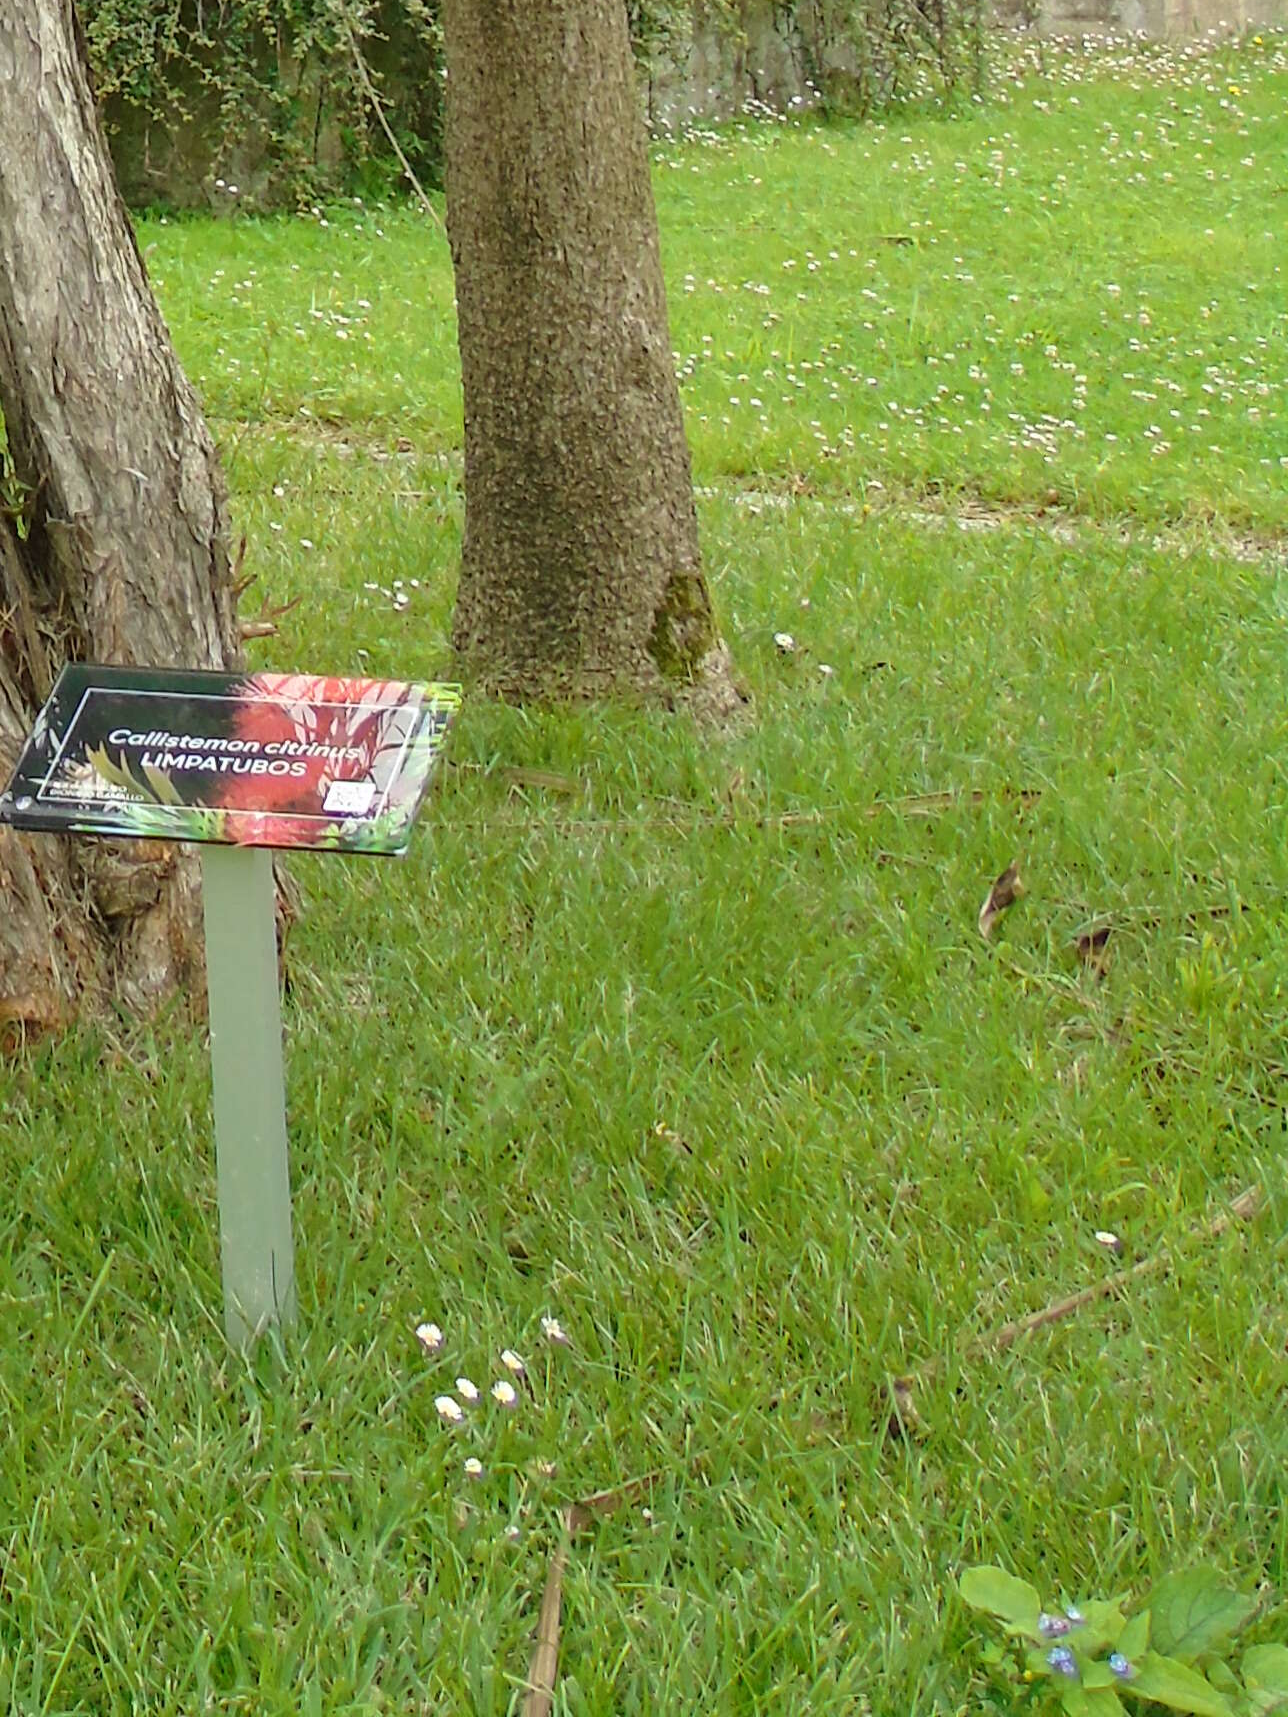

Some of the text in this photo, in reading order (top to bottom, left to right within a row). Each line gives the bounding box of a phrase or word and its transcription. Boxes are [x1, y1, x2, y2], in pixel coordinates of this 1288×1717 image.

[109, 728, 362, 759] Callistemon citrinus
[140, 751, 308, 776] LIMPATUBOS
